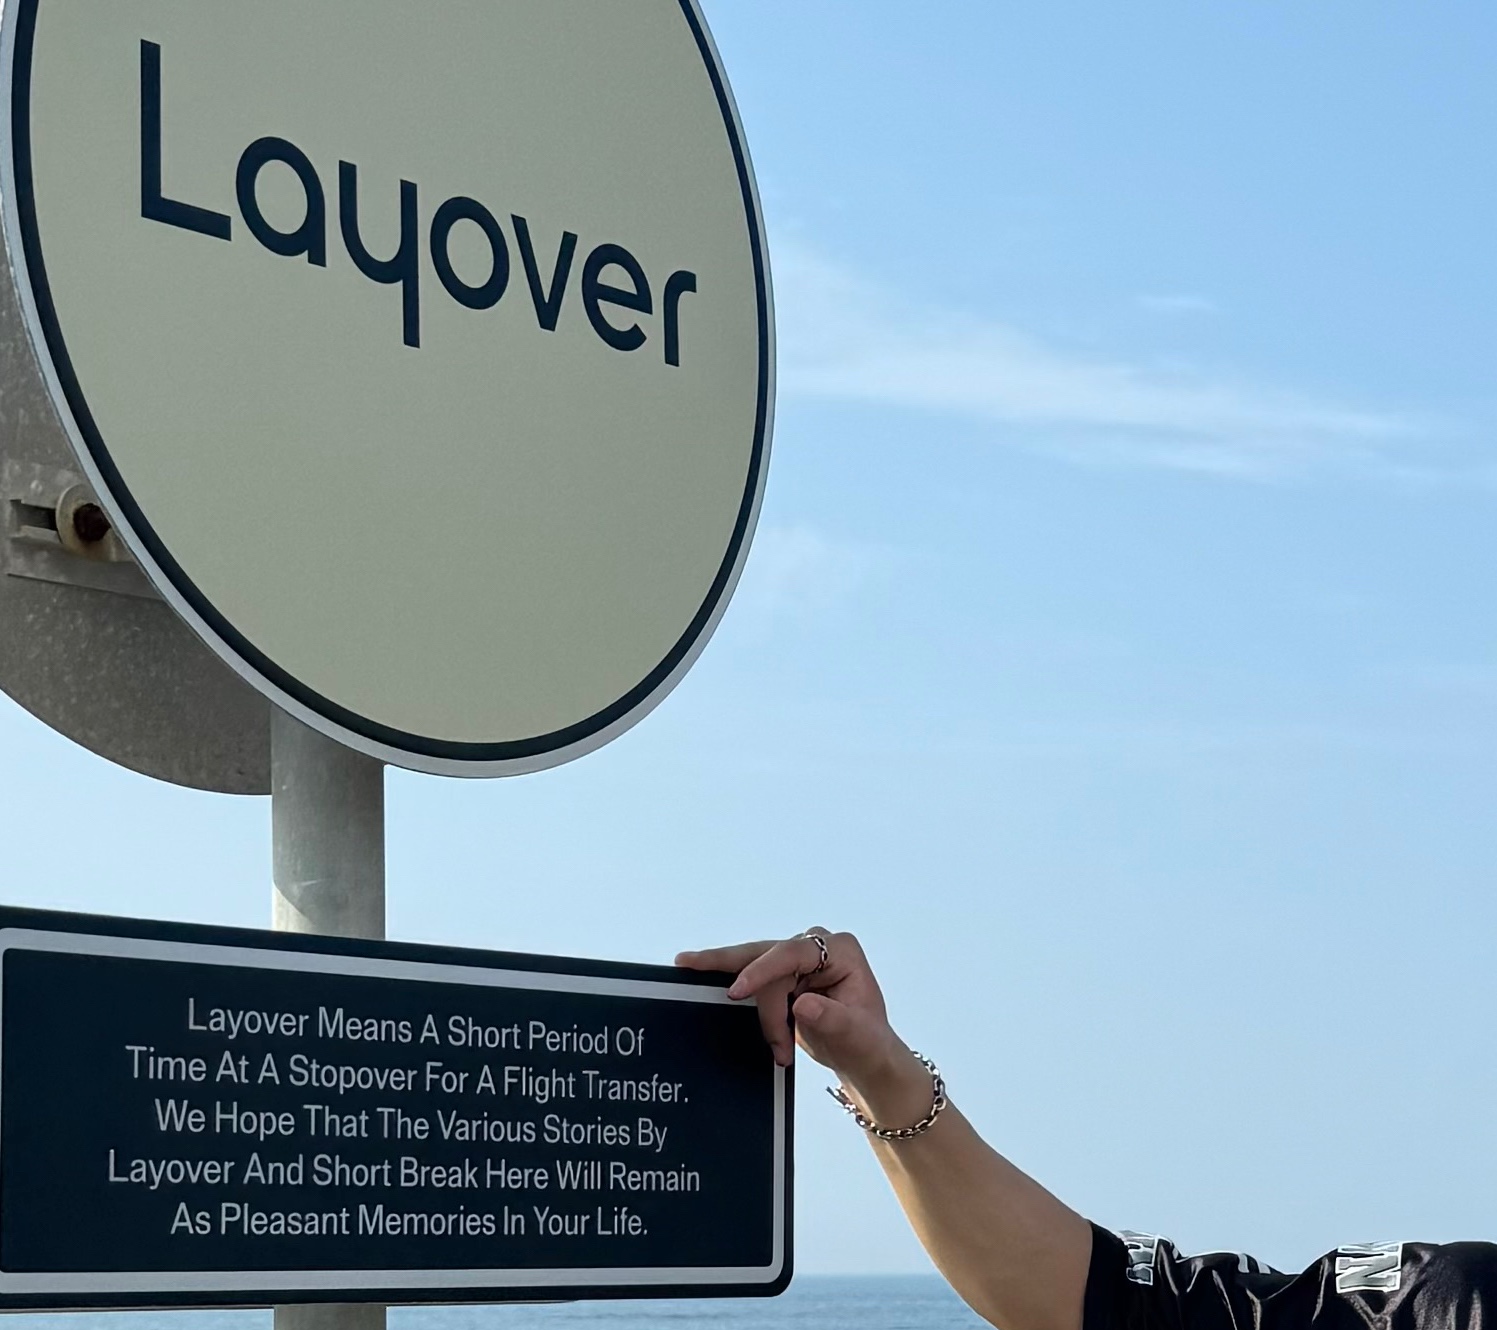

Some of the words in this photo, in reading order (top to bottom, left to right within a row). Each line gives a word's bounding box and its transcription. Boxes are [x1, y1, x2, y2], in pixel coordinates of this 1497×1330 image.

[140, 39, 697, 367] Layover
[188, 997, 310, 1040] Layover
[318, 1006, 412, 1043] Means
[419, 1014, 440, 1045] A
[447, 1015, 521, 1050] Short
[528, 1020, 608, 1055] Period
[616, 1026, 645, 1056] Of
[125, 1045, 207, 1082] Time
[215, 1050, 249, 1084] At
[257, 1053, 280, 1085] A
[289, 1054, 418, 1095] Stopover
[425, 1061, 469, 1093] For
[476, 1064, 496, 1095] A
[504, 1065, 576, 1104] Flight
[582, 1070, 689, 1103] Transfer.
[154, 1098, 206, 1133] We
[215, 1101, 295, 1142] Hope
[303, 1104, 369, 1138] That
[376, 1107, 430, 1140] The
[436, 1109, 536, 1143] Various
[543, 1113, 631, 1146] Stories
[637, 1117, 668, 1153] By
[109, 1148, 235, 1190] Layover
[243, 1152, 303, 1185] And
[312, 1153, 392, 1187] Short
[400, 1156, 479, 1189] Break
[486, 1158, 549, 1190] Here
[556, 1159, 601, 1190] Will
[609, 1161, 700, 1192] Remain
[170, 1202, 211, 1235] As
[220, 1202, 350, 1235] Pleasant
[358, 1204, 496, 1236] Memories
[503, 1205, 525, 1235] In
[533, 1206, 590, 1236] Your
[597, 1206, 648, 1236] Life.
